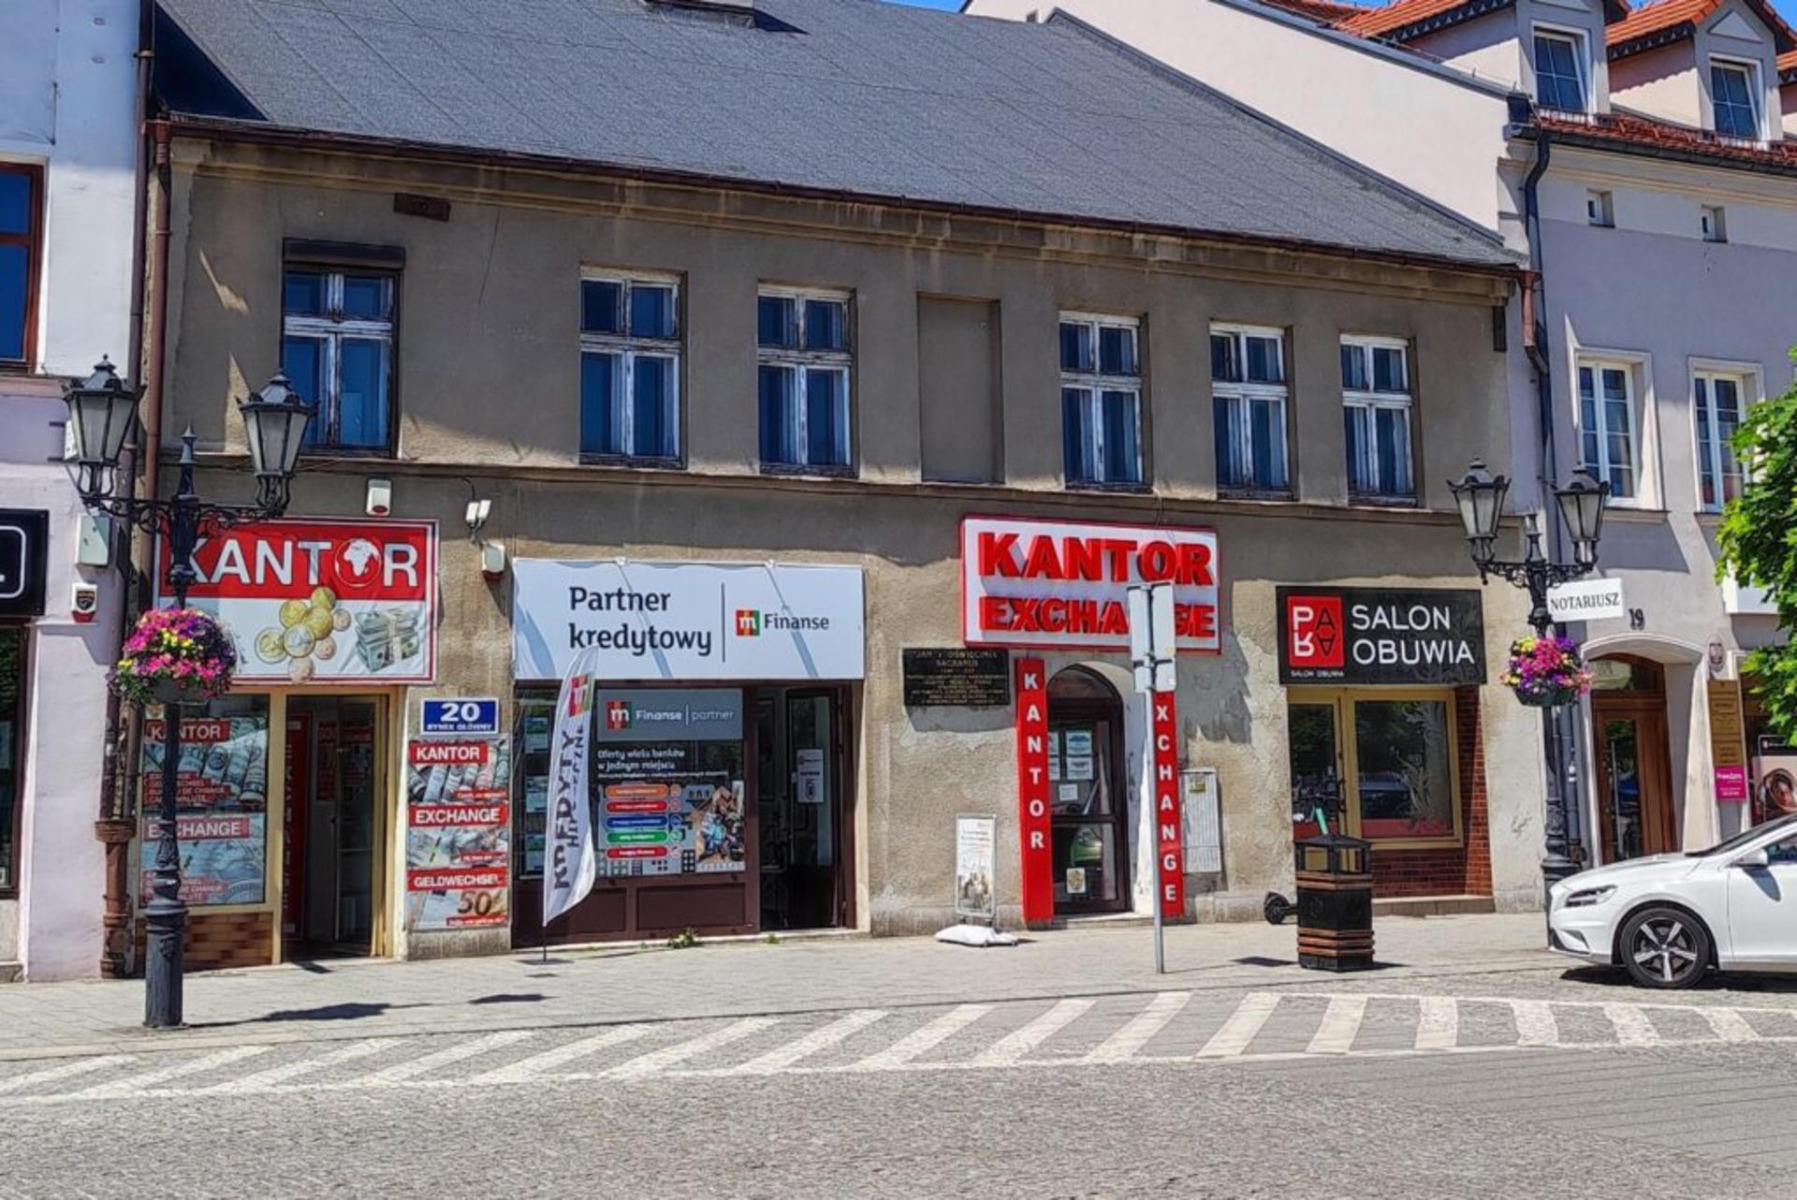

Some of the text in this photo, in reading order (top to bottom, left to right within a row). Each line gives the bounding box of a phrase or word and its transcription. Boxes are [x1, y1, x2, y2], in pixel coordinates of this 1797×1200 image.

[978, 531, 1214, 586] KANTOR
[568, 586, 671, 611] Partner
[1550, 592, 1620, 612] NOTARIUSZ
[763, 613, 830, 630] Finanse
[1351, 604, 1451, 630] SALON
[1629, 608, 1645, 630] 19
[568, 623, 712, 656] kredytowy
[1352, 638, 1475, 664] OBUWIA
[440, 702, 481, 722] 20
[635, 709, 683, 721] Finanse
[691, 709, 735, 723] partner
[151, 725, 221, 740] KNTOR
[416, 746, 480, 761] KANTOR
[1023, 673, 1044, 849] KANTOR
[415, 808, 501, 823] EXCHANGE
[413, 873, 500, 888] GELDWECHSEL
[457, 891, 492, 916] 50
